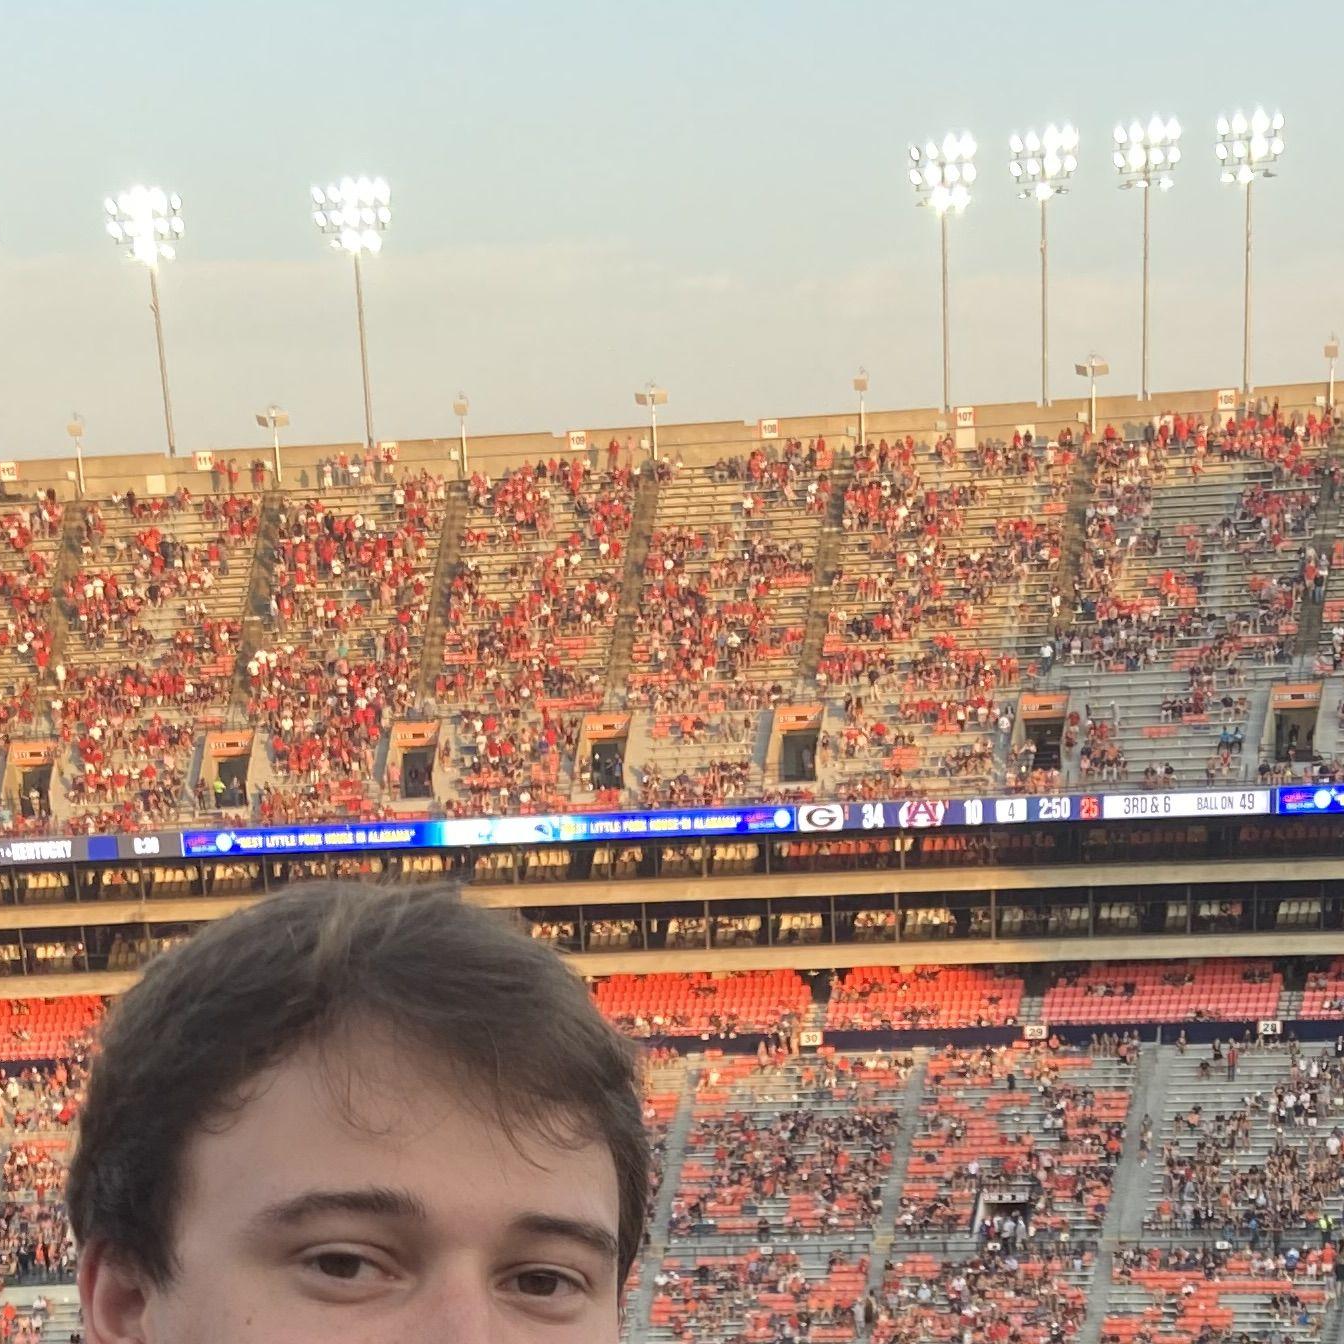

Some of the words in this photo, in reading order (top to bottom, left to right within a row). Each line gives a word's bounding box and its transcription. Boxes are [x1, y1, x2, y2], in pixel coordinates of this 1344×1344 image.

[862, 803, 885, 829] 34
[964, 799, 983, 825] 10
[1008, 802, 1015, 819] 4
[1039, 798, 1071, 819] 2:50
[1123, 797, 1148, 815] 3RD
[1150, 797, 1159, 814] &
[1163, 796, 1172, 813] 6
[1197, 796, 1219, 811] BALL
[1220, 795, 1234, 810] ON
[1239, 793, 1256, 810] 49
[1029, 1028, 1043, 1037] 29
[805, 1034, 818, 1043] 30
